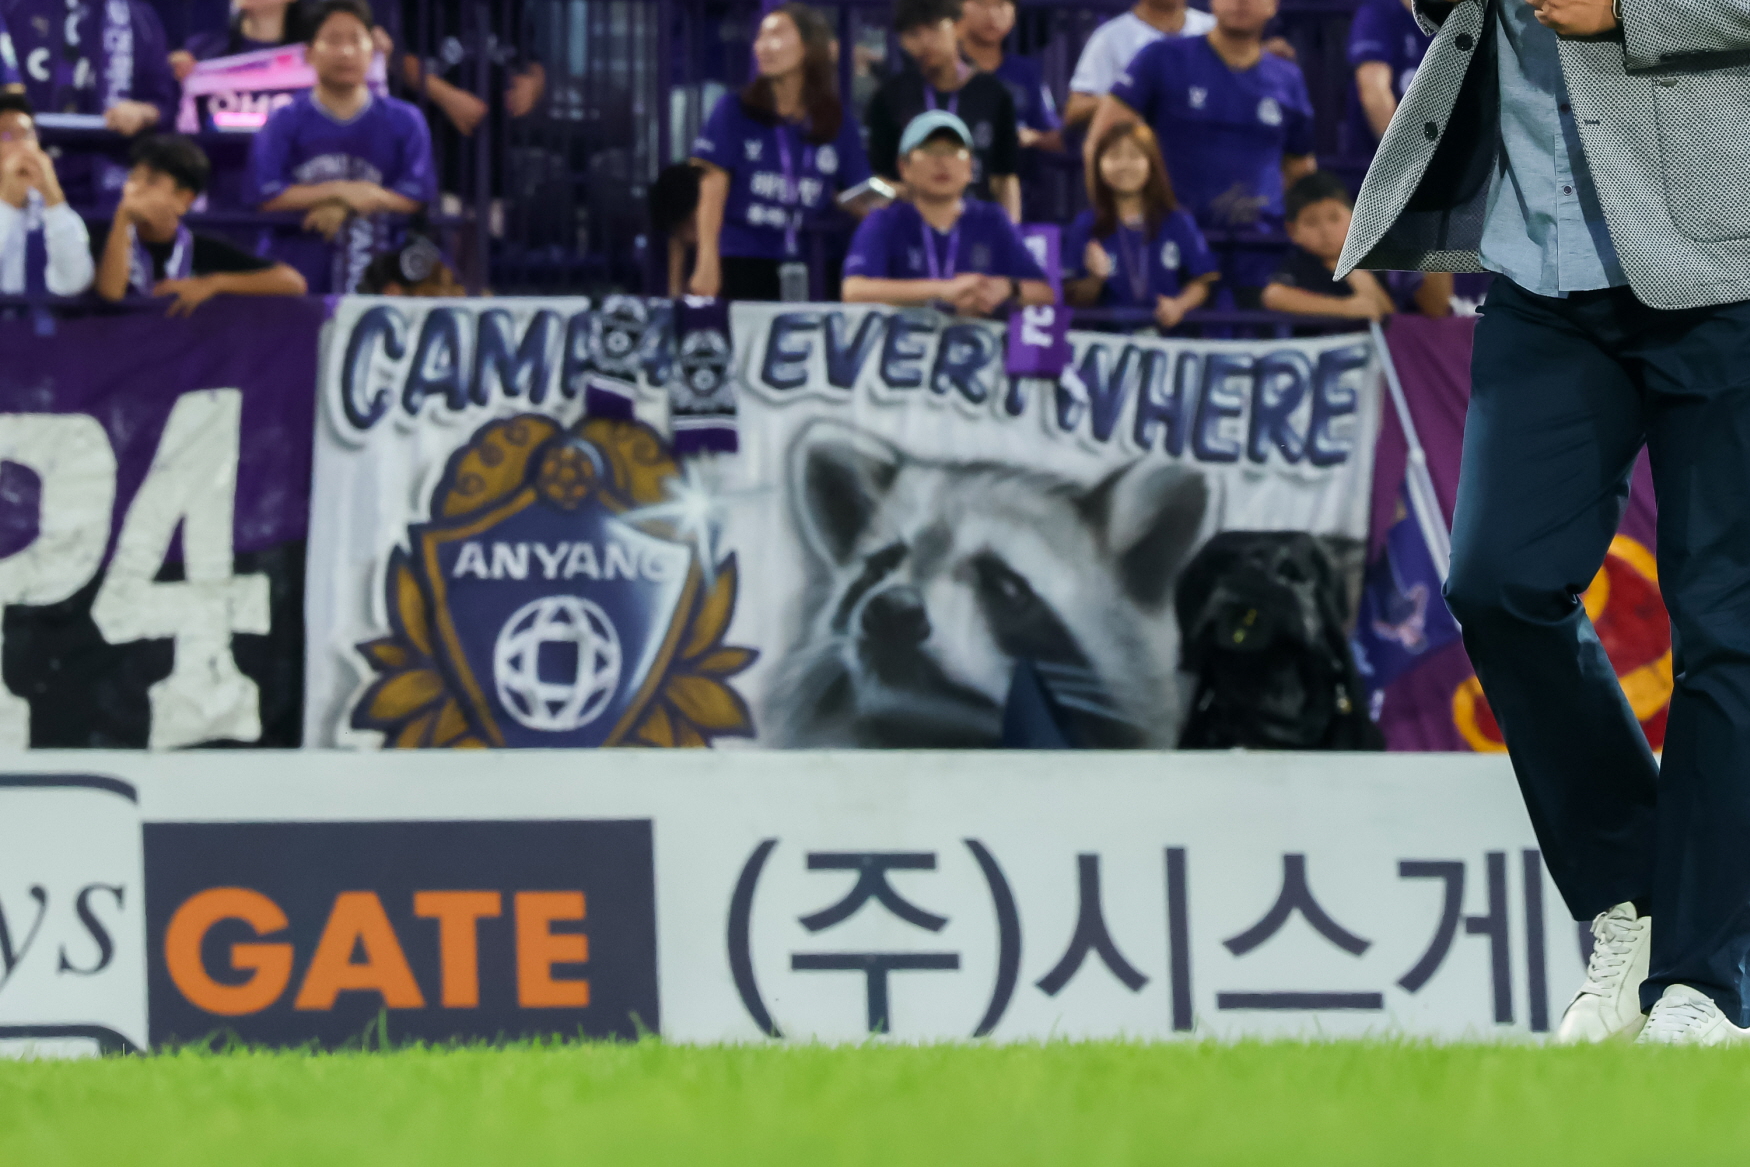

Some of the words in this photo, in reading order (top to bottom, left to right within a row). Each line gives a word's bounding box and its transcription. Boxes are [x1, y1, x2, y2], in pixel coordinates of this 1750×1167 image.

[760, 311, 1368, 467] EVERWHERE
[453, 542, 684, 582] ANYANG
[164, 886, 590, 1016] GATE
